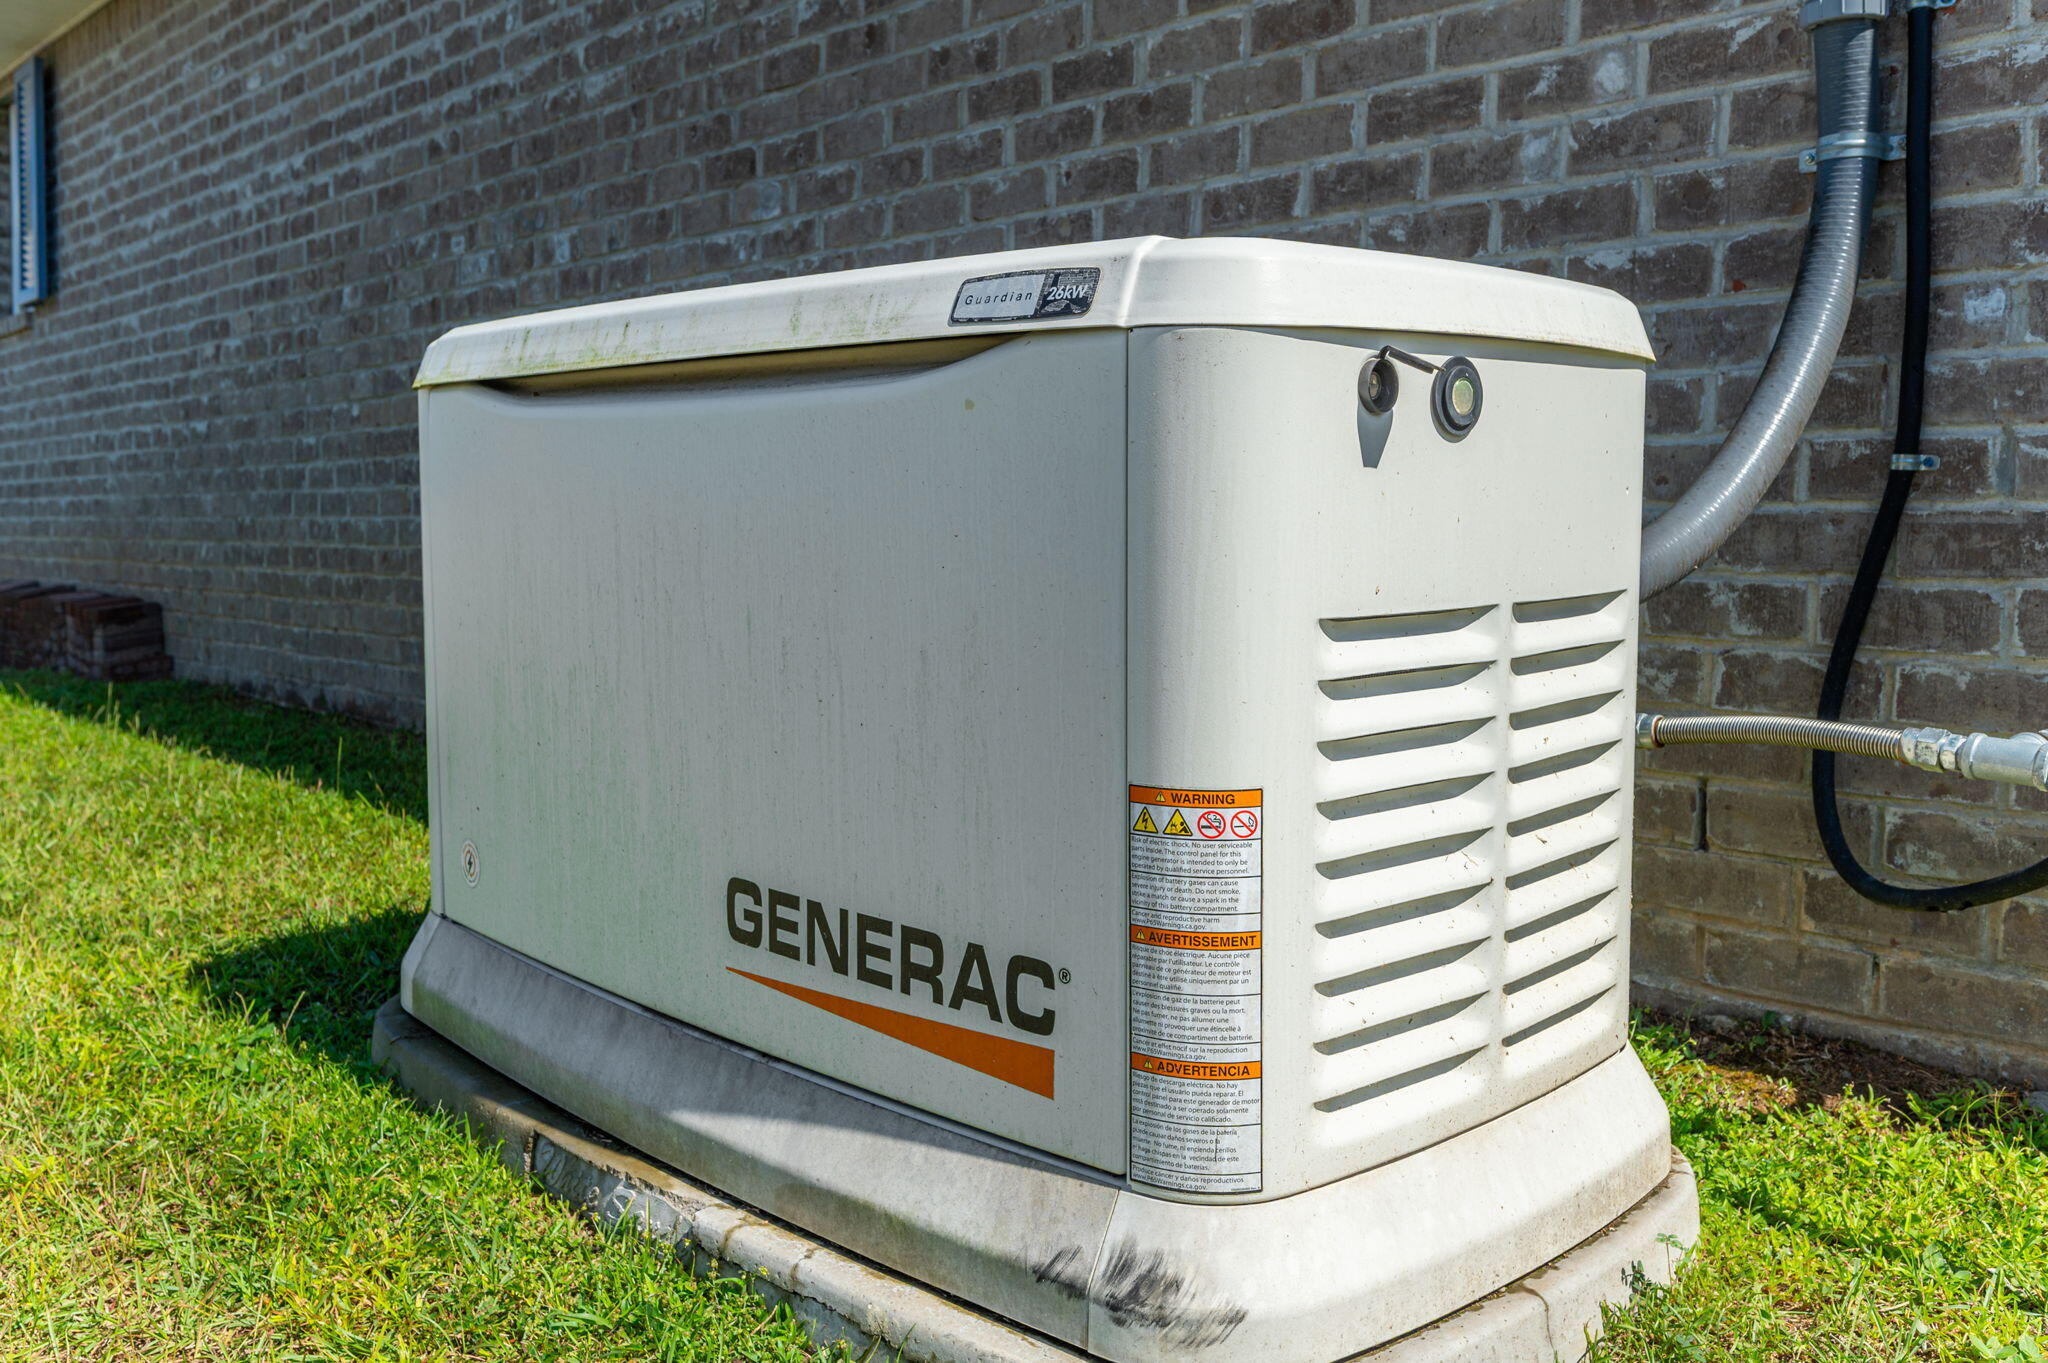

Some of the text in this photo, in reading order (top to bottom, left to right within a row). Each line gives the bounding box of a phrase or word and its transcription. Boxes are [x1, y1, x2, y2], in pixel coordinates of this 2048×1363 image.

[964, 284, 1089, 306] Guardian 26kW
[1171, 792, 1235, 805] WARNING
[1165, 877, 1187, 886] battery
[1170, 903, 1192, 912] battery
[1163, 915, 1202, 923] reproductive
[1149, 932, 1256, 948] AVERTISSEMENT
[1189, 978, 1228, 986] uniquement
[1165, 1024, 1195, 1032] provoquer
[1207, 1047, 1248, 1055] reproduction
[1157, 1061, 1251, 1077] ADVERTENCIA
[1159, 1077, 1185, 1088] descarga
[1227, 1082, 1238, 1090] hay
[1154, 1140, 1162, 1148] No
[1180, 1175, 1199, 1183] daños
[1200, 1177, 1244, 1186] reproductivos
